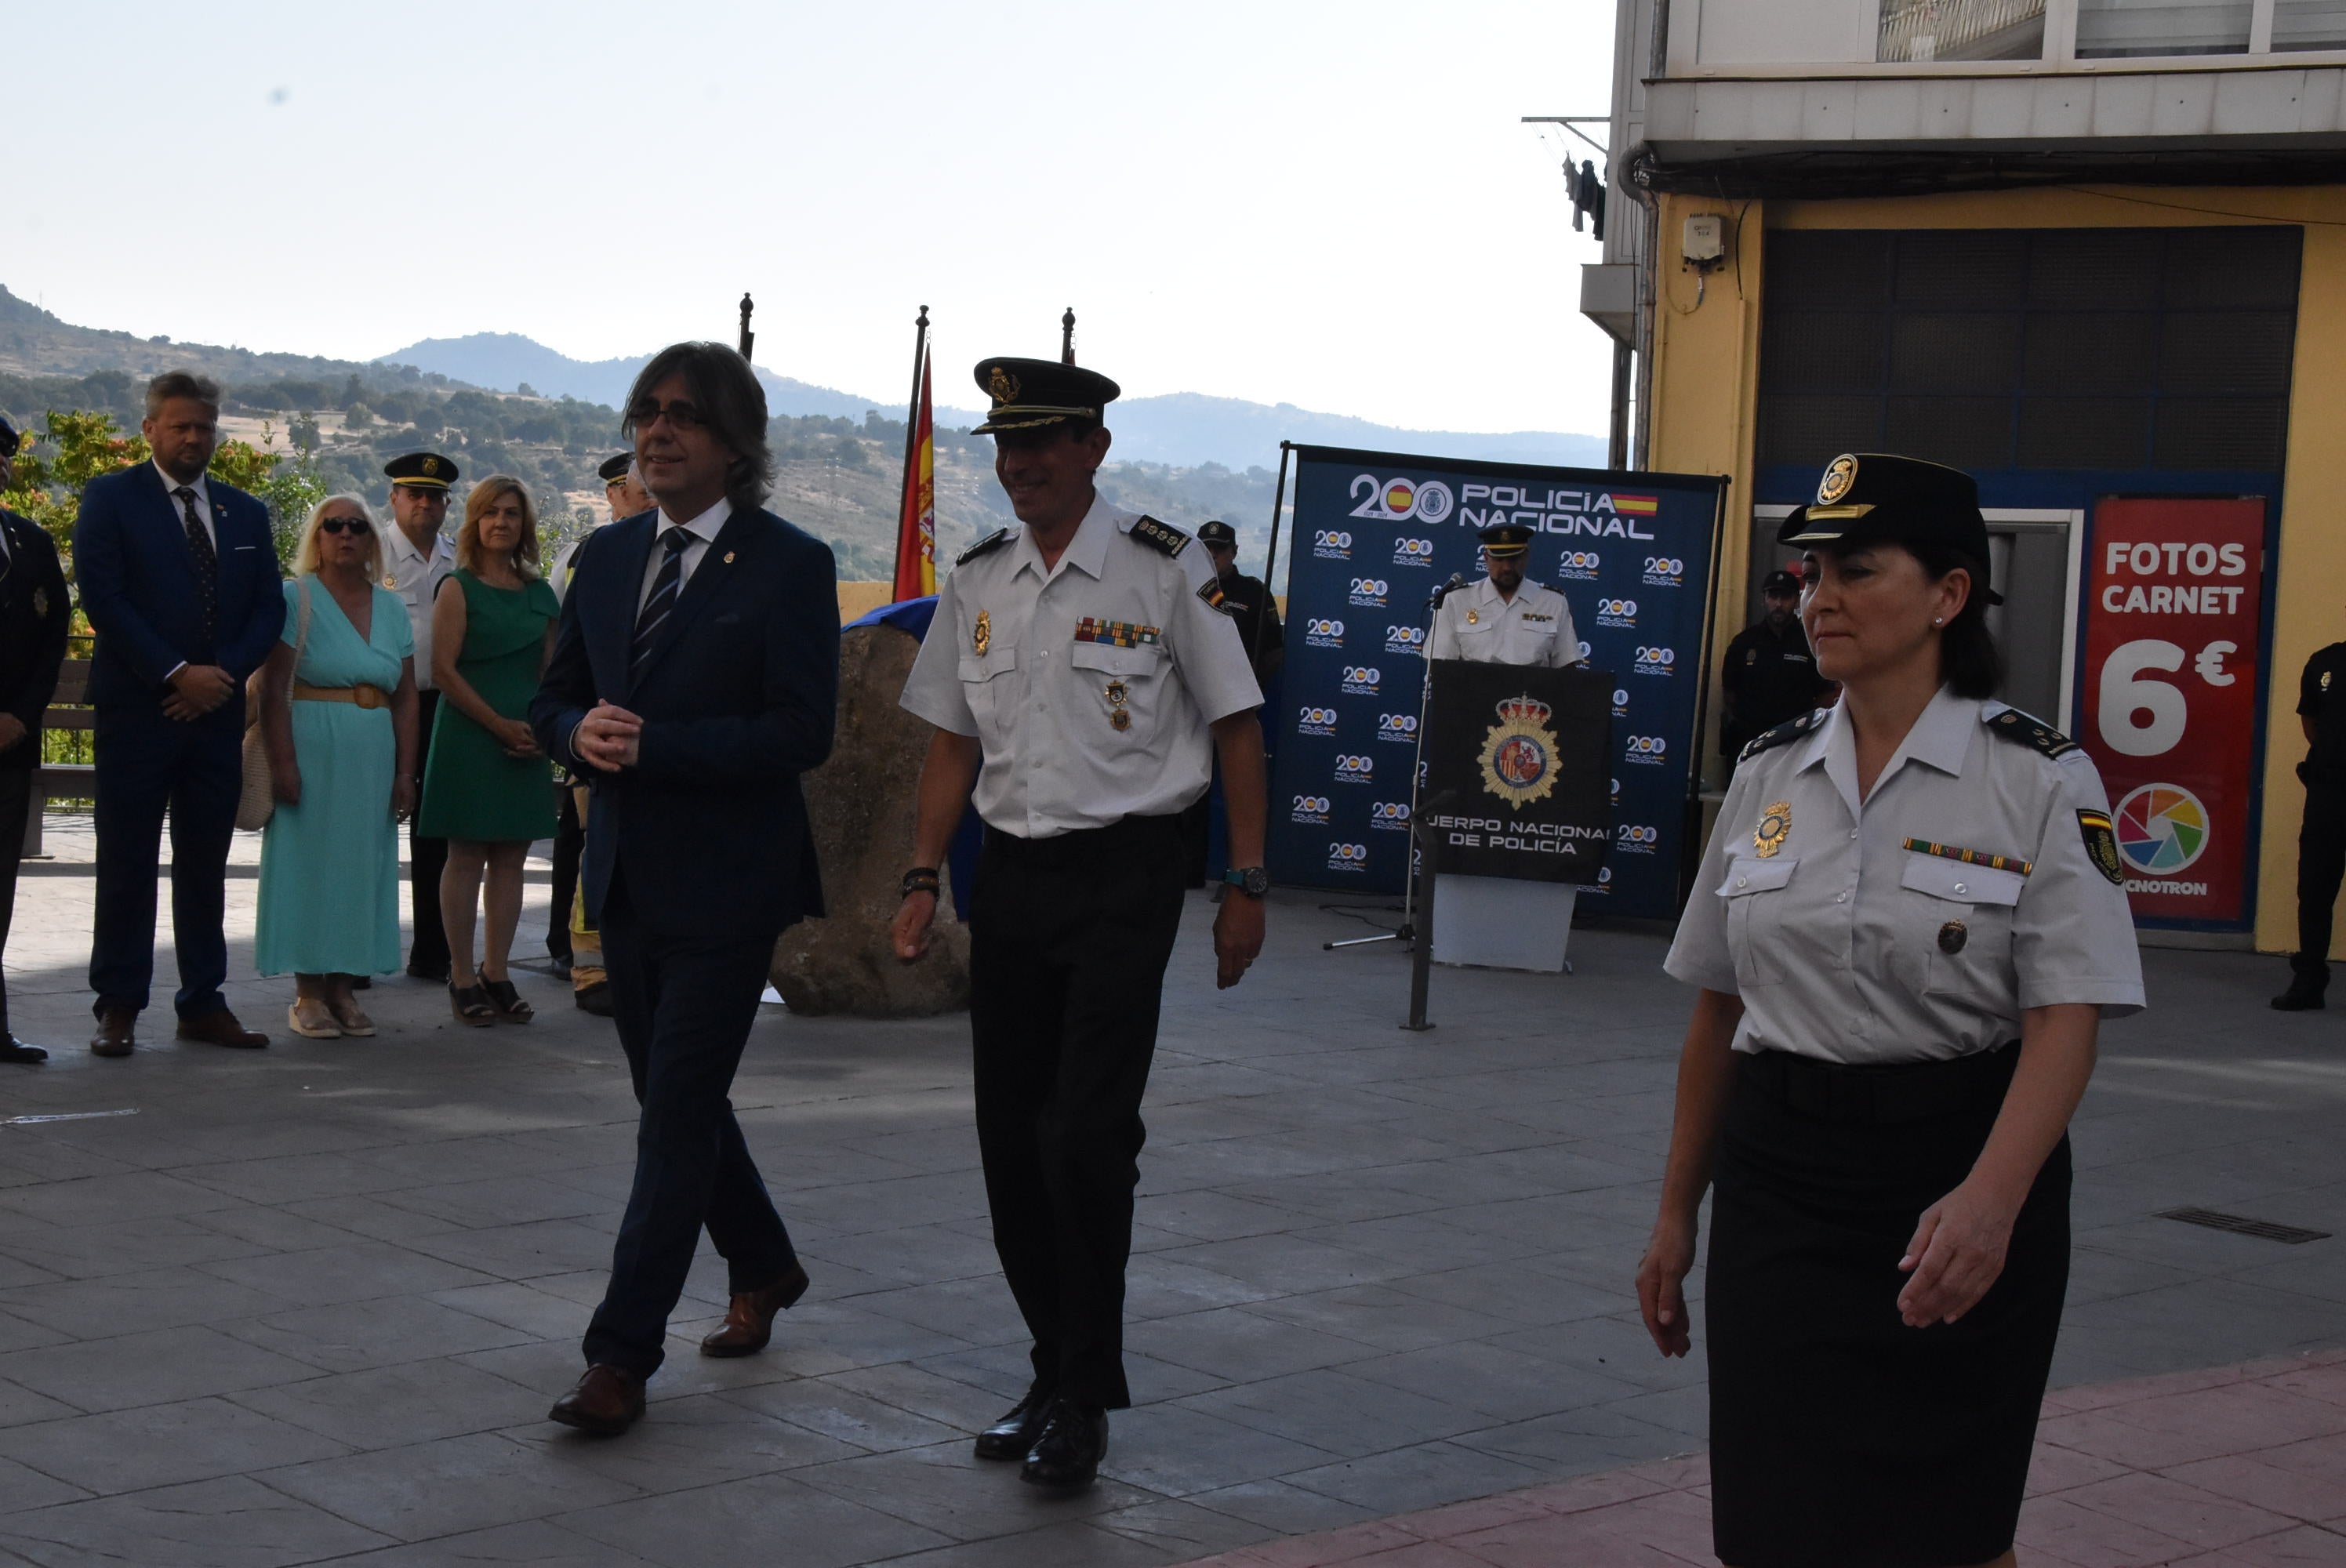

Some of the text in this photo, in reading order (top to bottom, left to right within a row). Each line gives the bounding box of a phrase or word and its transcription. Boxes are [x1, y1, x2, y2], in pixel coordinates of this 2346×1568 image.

[1349, 474, 1454, 524] 200
[1459, 507, 1654, 540] NACIONAL
[2106, 542, 2246, 576] FOTOS
[2102, 585, 2245, 615] CARNET
[1426, 815, 1501, 832] UERPO
[1449, 833, 1578, 855] DE POLICÍA
[2124, 879, 2207, 895] CNOTRON
